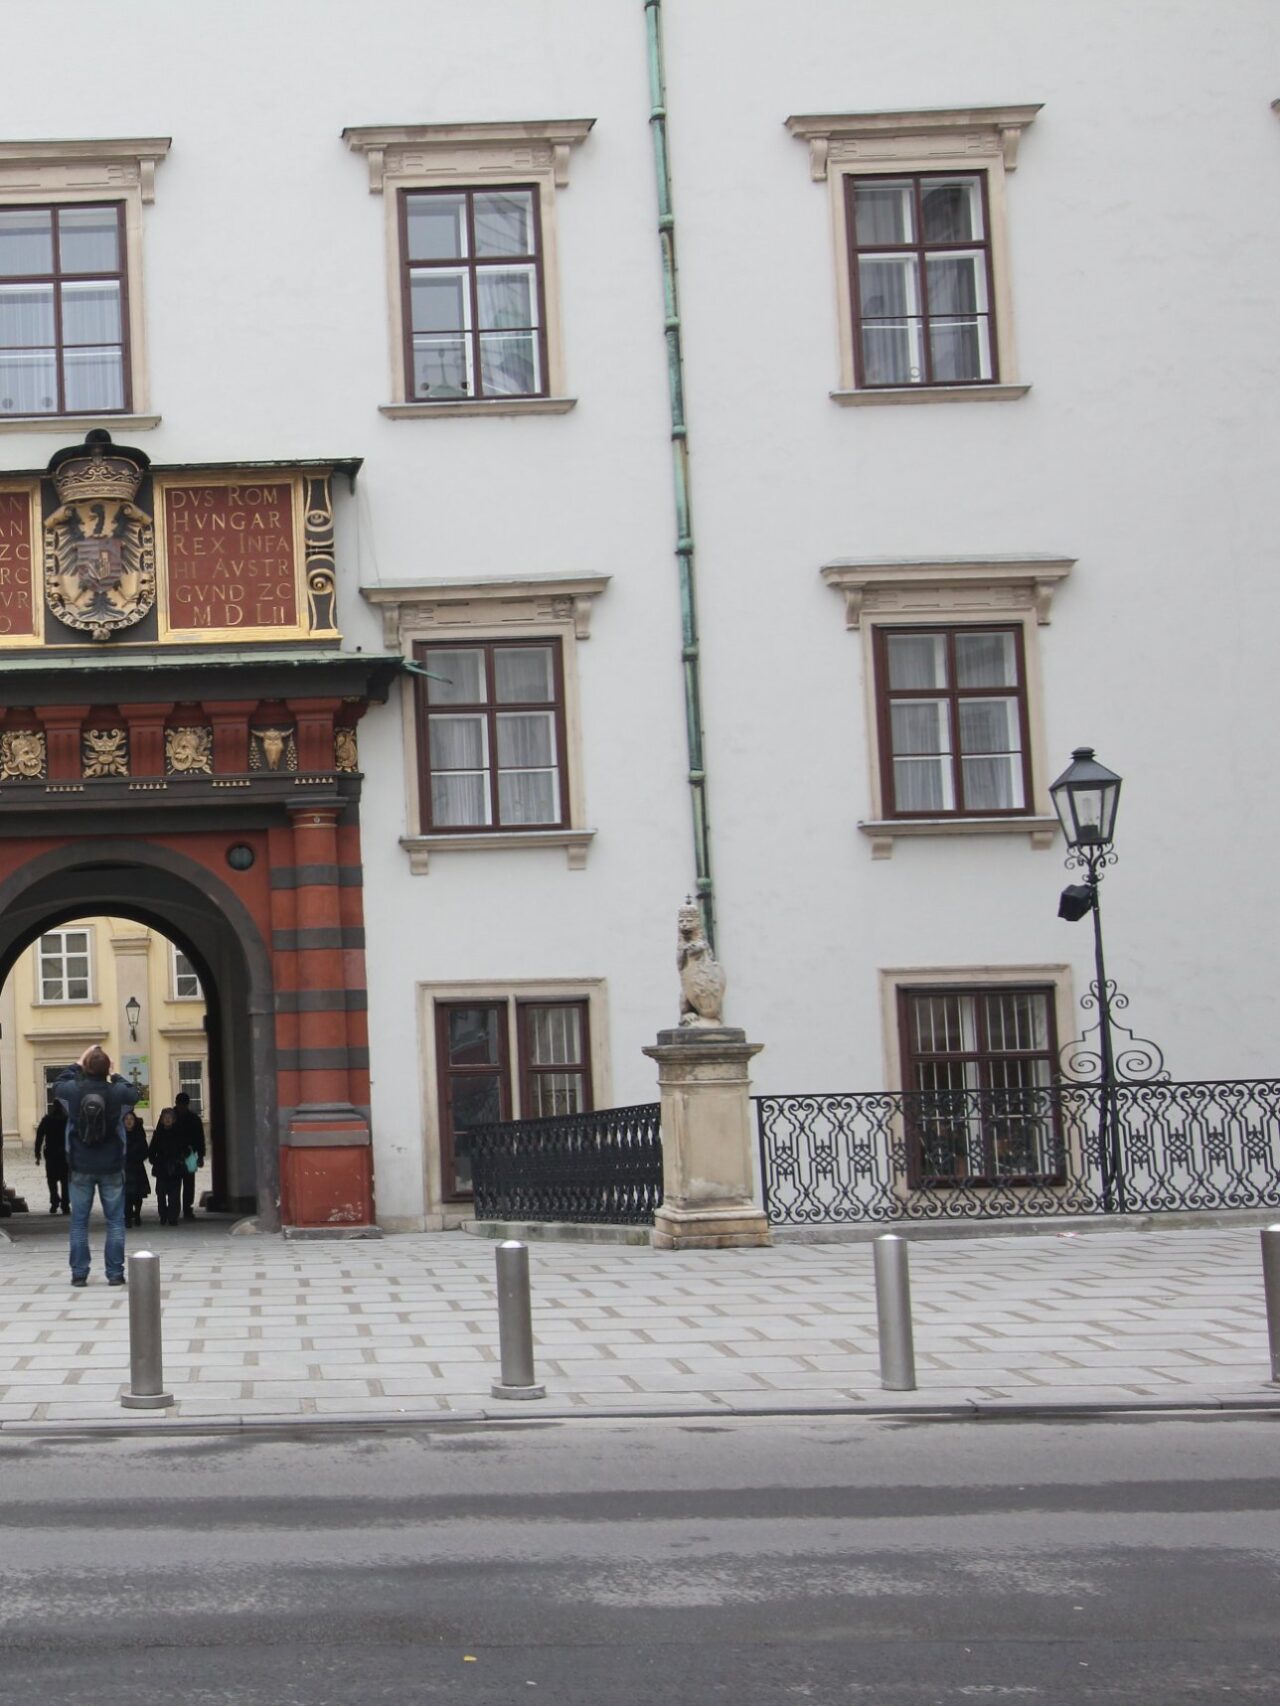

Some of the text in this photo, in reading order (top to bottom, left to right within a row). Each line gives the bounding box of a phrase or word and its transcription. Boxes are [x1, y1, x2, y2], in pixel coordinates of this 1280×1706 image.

[171, 486, 278, 508] DVS ROM
[172, 511, 281, 532] HVNGAR
[173, 533, 289, 555] REX INFA
[174, 559, 289, 579] HI AVSTR
[176, 583, 292, 603] GVND ZC
[194, 605, 211, 626] M
[225, 604, 243, 625] D
